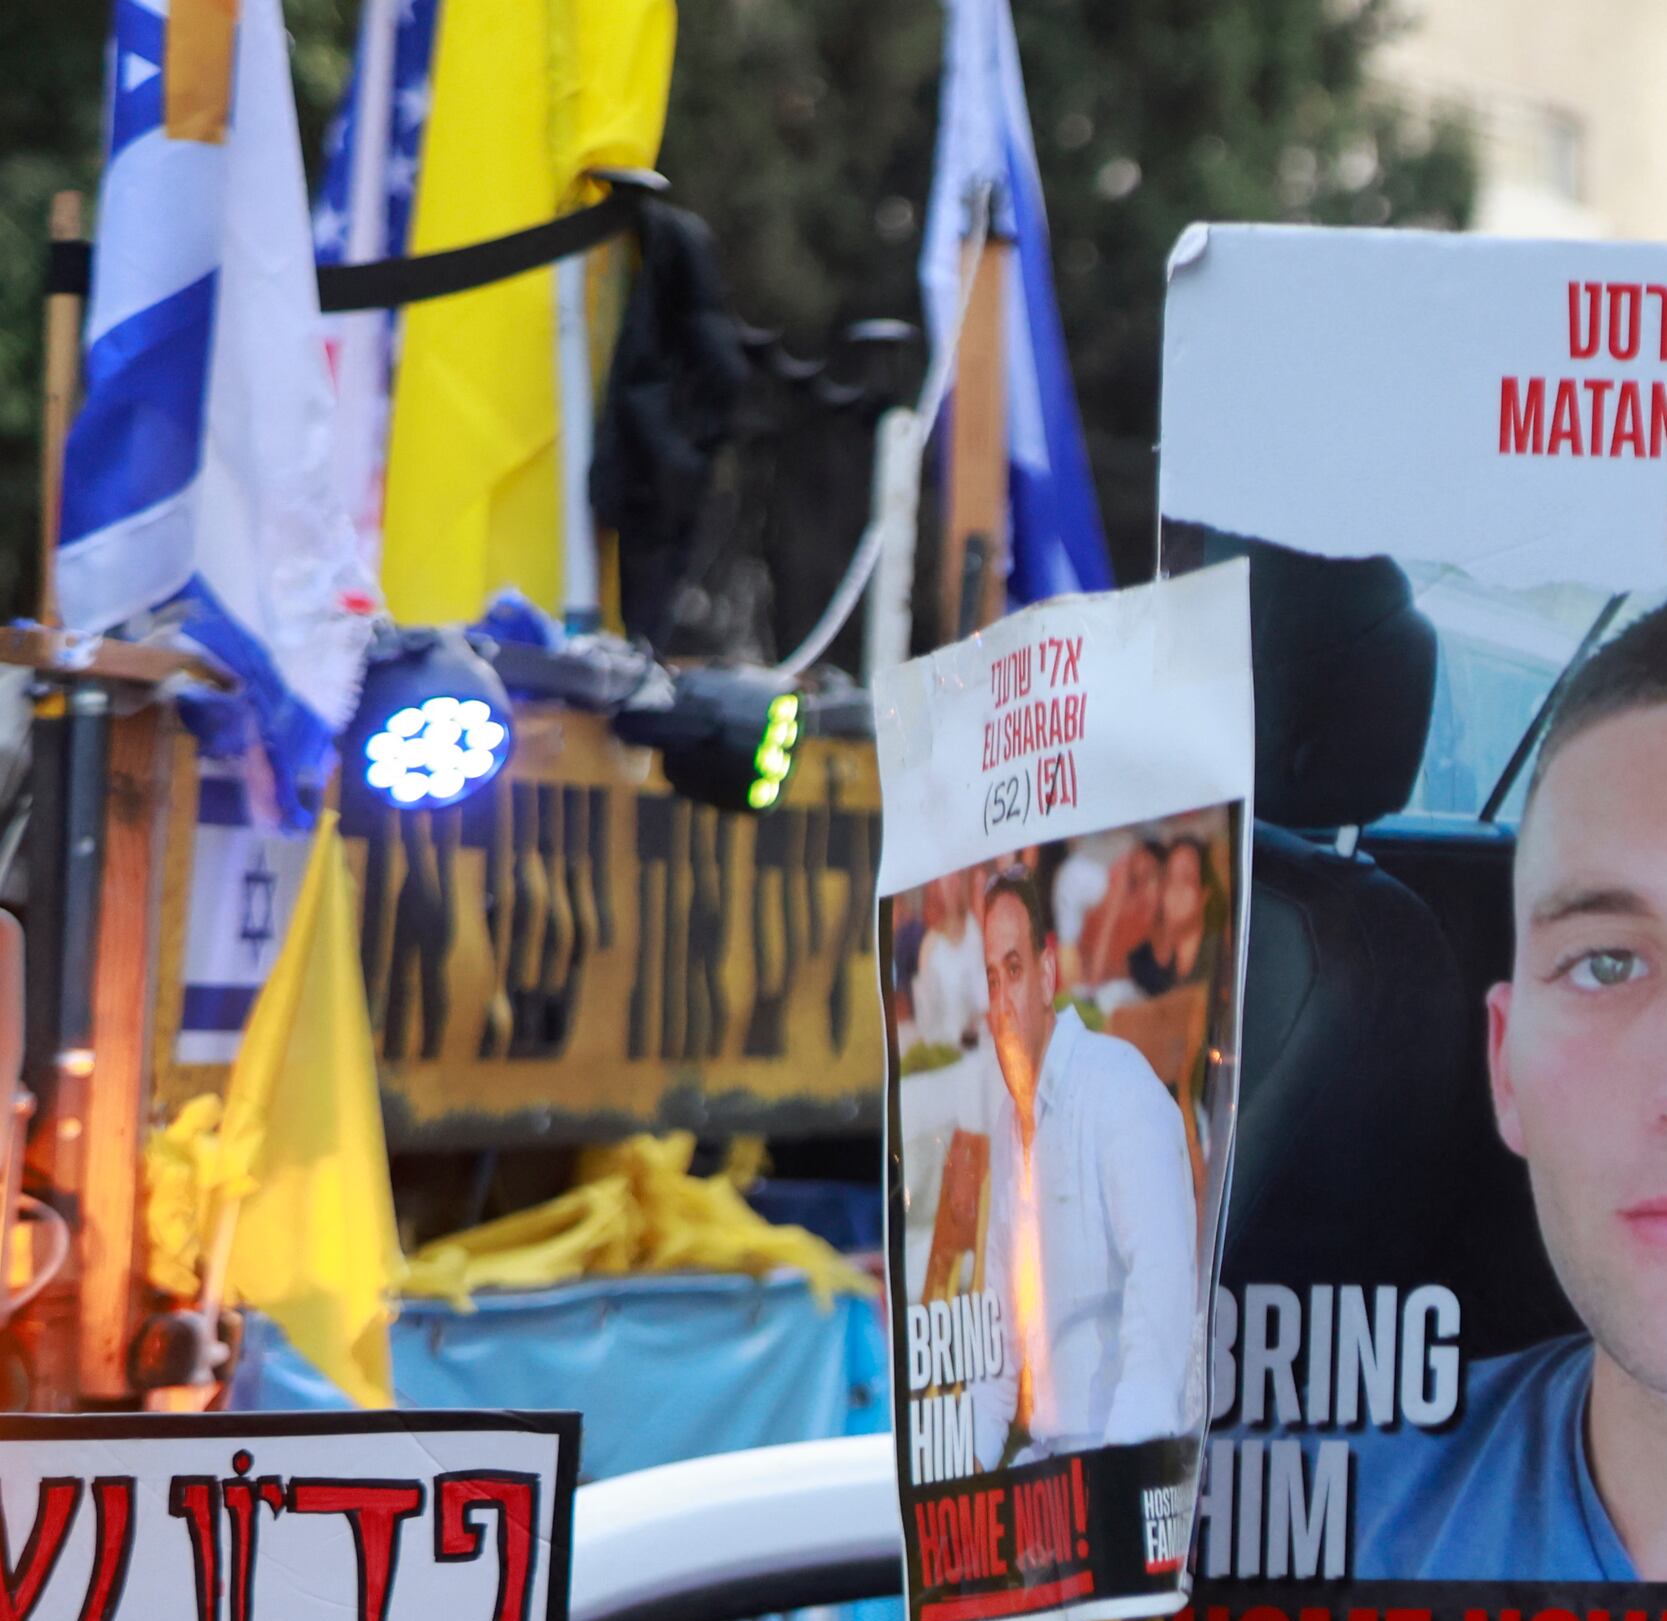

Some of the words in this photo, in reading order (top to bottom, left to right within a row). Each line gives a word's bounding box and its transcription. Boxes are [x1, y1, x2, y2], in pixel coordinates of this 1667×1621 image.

[992, 644, 1031, 709] שרעבי
[1039, 635, 1083, 688] אלי
[982, 718, 1000, 772] ELI
[1004, 692, 1087, 763] SHARABI
[983, 769, 1031, 836] (52)
[908, 1289, 1003, 1390] BRING
[911, 1391, 973, 1486] HIM
[915, 1489, 1006, 1588] HOME
[1014, 1457, 1088, 1572] NOW!
